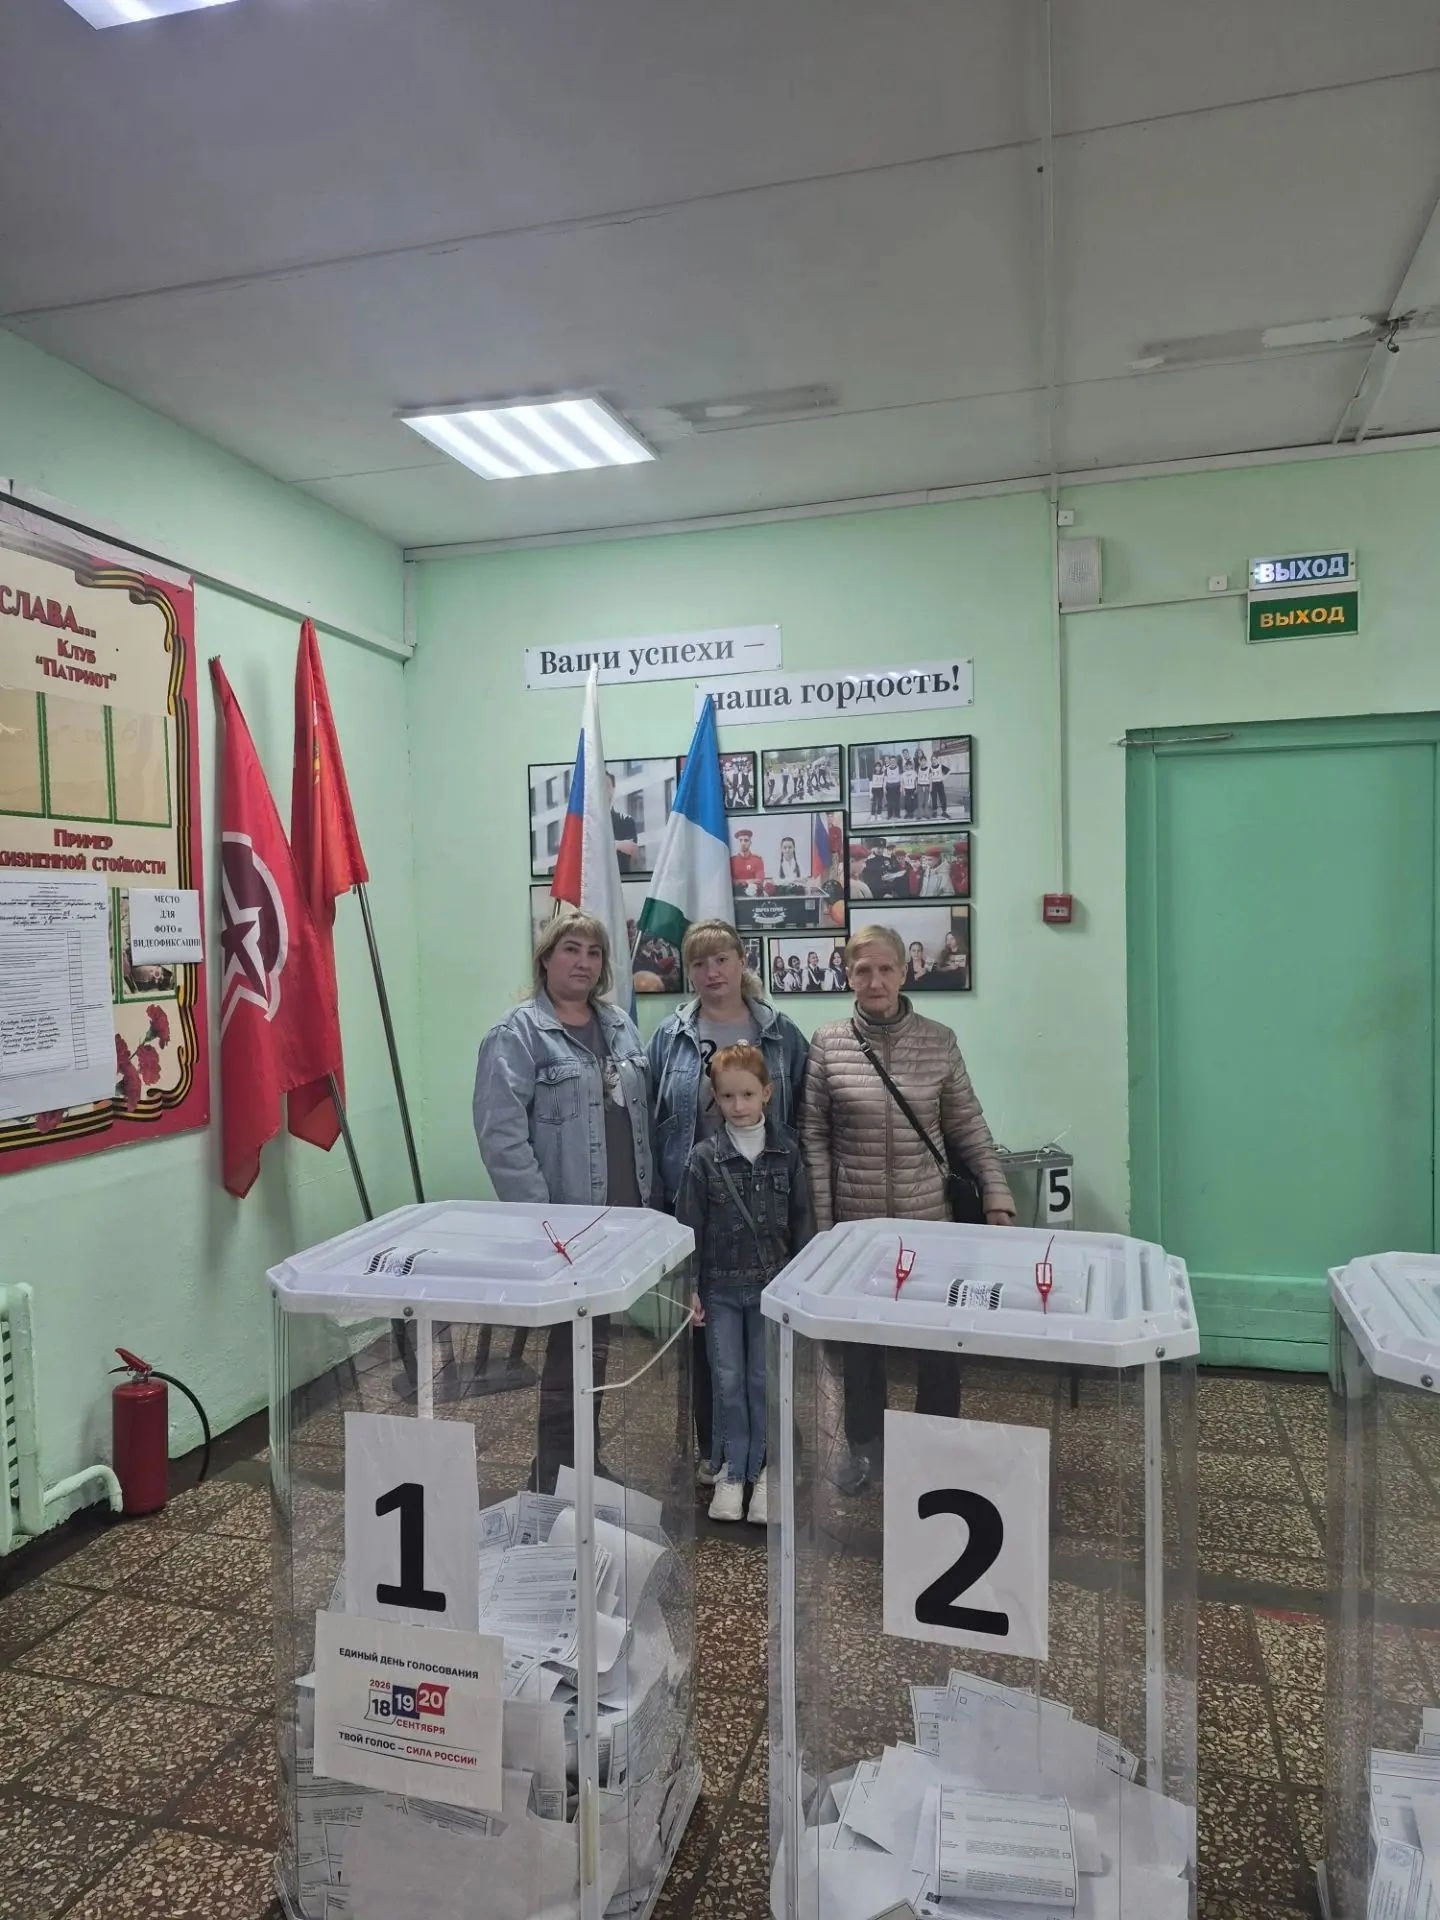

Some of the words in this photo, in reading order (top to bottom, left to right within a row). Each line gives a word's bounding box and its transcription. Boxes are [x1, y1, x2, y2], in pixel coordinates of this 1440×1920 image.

[1259, 556, 1345, 583] ВЫХОД
[1259, 606, 1345, 628] ВЫХОД
[540, 651, 621, 675] Ваши
[628, 639, 734, 675] успехи
[800, 664, 961, 709] гордость!
[92, 856, 167, 875] СТОЙКОСТИ
[154, 895, 180, 904] МЕСТО
[160, 910, 175, 919] ДЛЯ
[154, 925, 177, 933] ФОТО
[1049, 1168, 1071, 1212] 5
[375, 1482, 446, 1612] 1
[915, 1488, 1009, 1636] 2
[339, 1647, 378, 1662] ЕДИНЫЙ
[380, 1656, 405, 1667] ДЕНЬ
[407, 1660, 479, 1679] ГОЛОСОВАНИЯ
[369, 1680, 391, 1690] 2026
[372, 1698, 391, 1717] 18
[394, 1694, 415, 1712] 19
[418, 1689, 443, 1709] 20
[396, 1719, 446, 1735] СЕНТЯБРЯ
[339, 1731, 363, 1744] ТВОЙ
[365, 1737, 396, 1751] ГОЛОС
[406, 1746, 432, 1758] СИЛА
[434, 1752, 478, 1766] РОССИИ!
